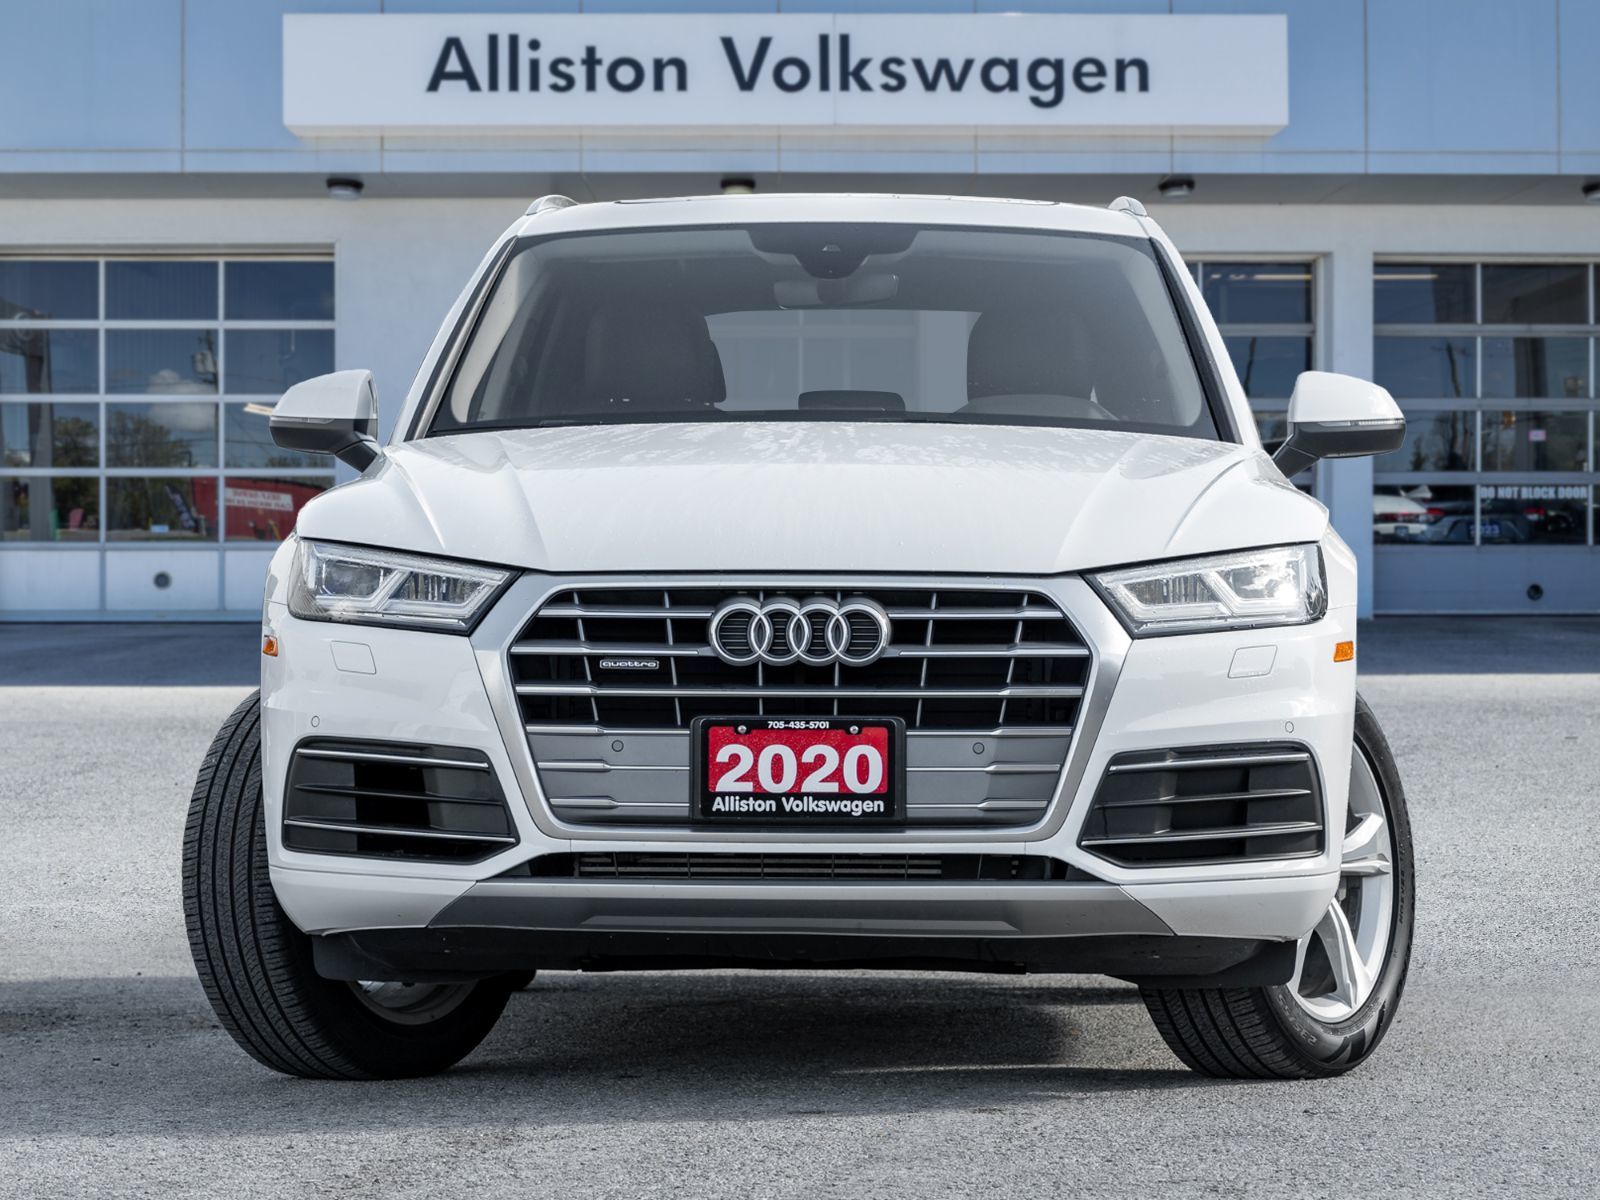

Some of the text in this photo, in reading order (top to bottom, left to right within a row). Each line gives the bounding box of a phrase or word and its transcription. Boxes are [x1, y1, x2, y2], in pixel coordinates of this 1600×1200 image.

[425, 33, 1151, 110] Alliston Volkswagen
[1480, 486, 1587, 499] DO NOT BLOCK DOOR
[602, 660, 657, 669] quattro
[767, 720, 830, 730] 705-435-5701
[715, 743, 883, 794] 2020
[712, 796, 885, 816] Alliston Volkswagen
